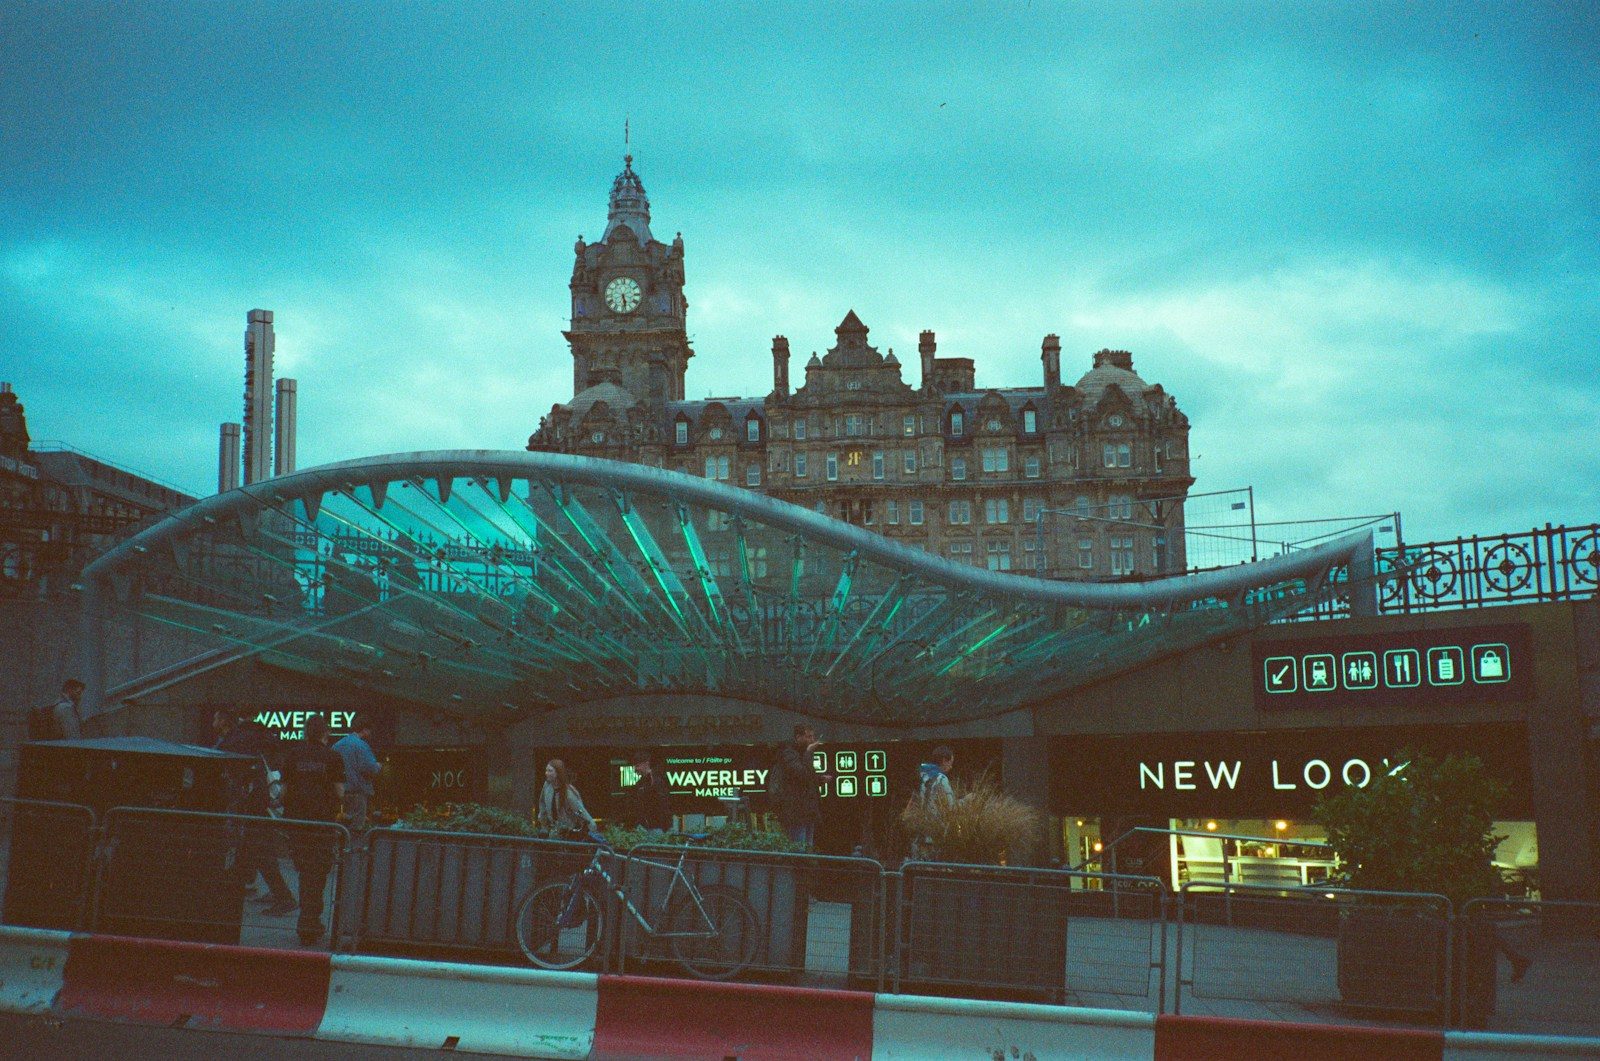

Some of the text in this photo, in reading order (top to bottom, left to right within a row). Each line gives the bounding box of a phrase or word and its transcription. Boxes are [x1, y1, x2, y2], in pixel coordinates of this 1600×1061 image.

[253, 711, 357, 728] WAVEEY
[666, 769, 769, 787] WAVERLEY
[1139, 760, 1242, 791] NEW
[695, 786, 740, 798] MARKE
